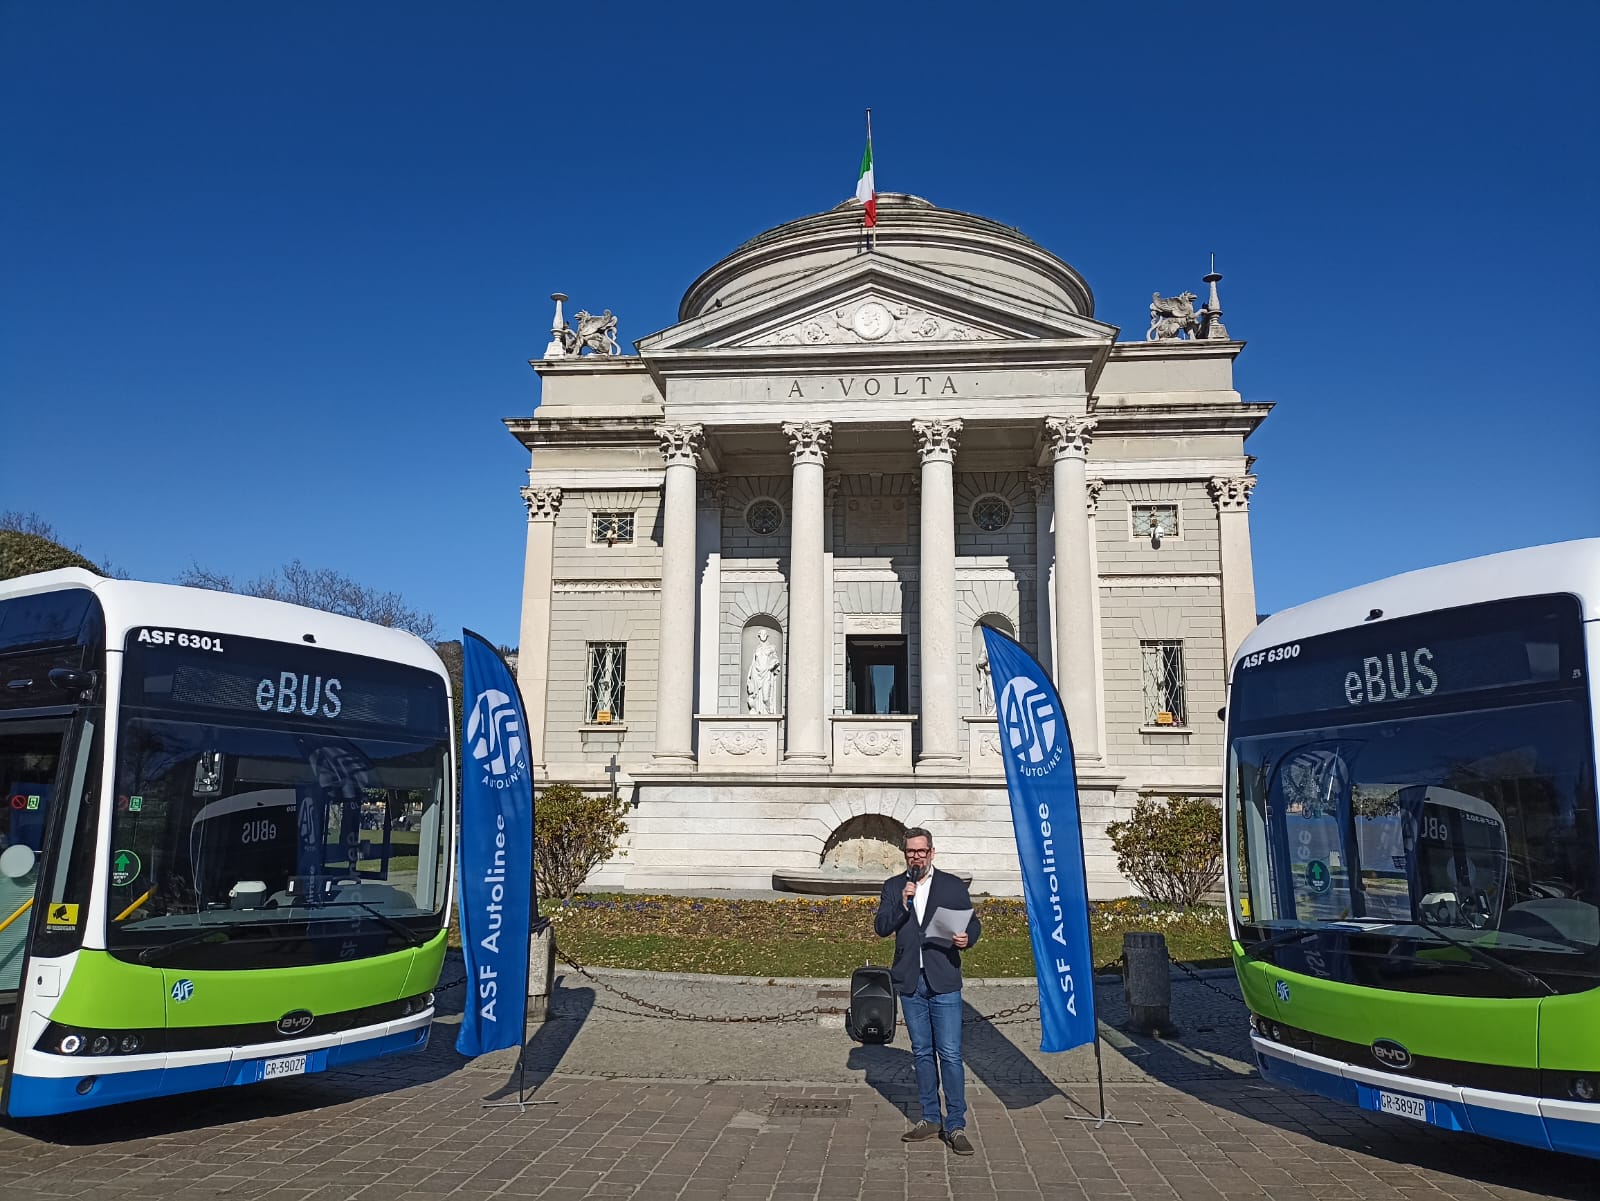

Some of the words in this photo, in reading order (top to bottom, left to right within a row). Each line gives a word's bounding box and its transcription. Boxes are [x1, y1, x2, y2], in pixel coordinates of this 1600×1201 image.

[788, 379, 805, 398] A
[837, 375, 958, 397] VOLTA
[137, 628, 176, 645] ASF
[177, 633, 224, 652] 6301
[1242, 652, 1267, 670] ASF
[1267, 643, 1301, 663] 6300
[255, 671, 342, 718] eBUS
[1343, 647, 1439, 705] eBUS
[1019, 744, 1063, 777] AUTOLINEE
[480, 813, 506, 954] Autolinee
[1037, 801, 1067, 946] Autolinee
[479, 964, 498, 1023] ASF
[1054, 958, 1078, 1017] ASF
[281, 1016, 311, 1028] BYD
[1374, 1046, 1406, 1061] BYD
